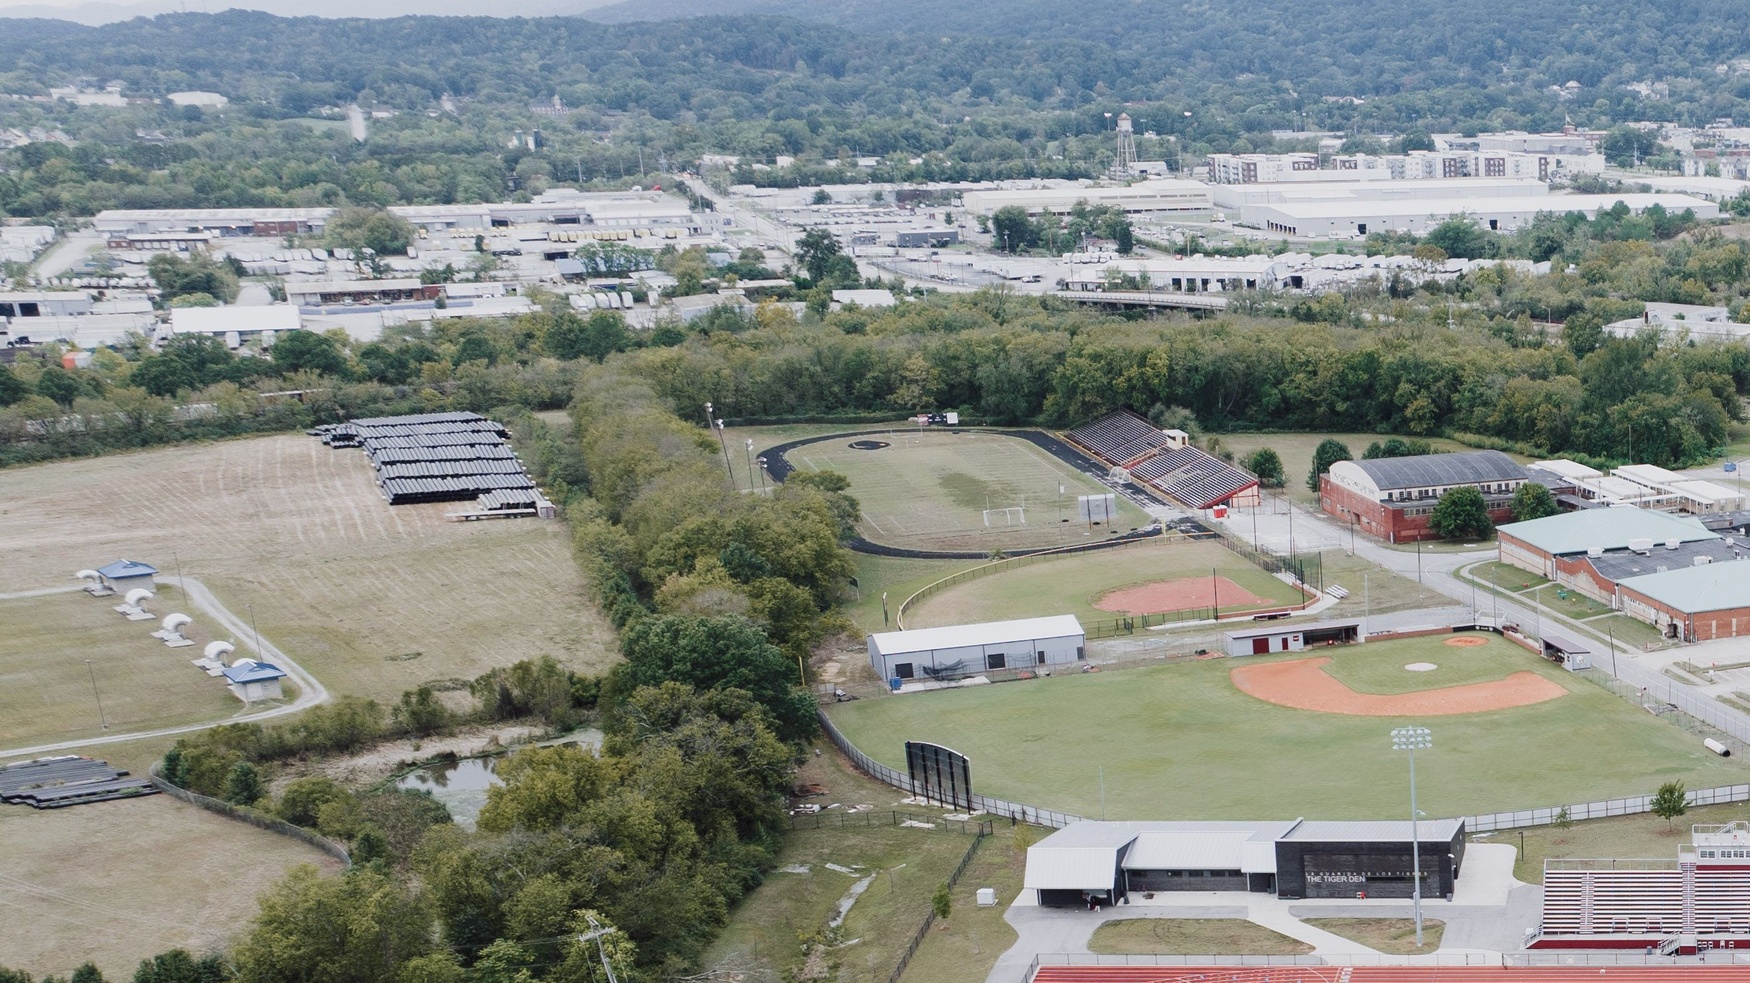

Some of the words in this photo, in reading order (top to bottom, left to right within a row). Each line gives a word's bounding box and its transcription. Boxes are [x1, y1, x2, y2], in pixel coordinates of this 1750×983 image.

[1306, 875, 1323, 883] THE
[1323, 875, 1348, 883] TIGER
[1348, 875, 1366, 883] DEN
